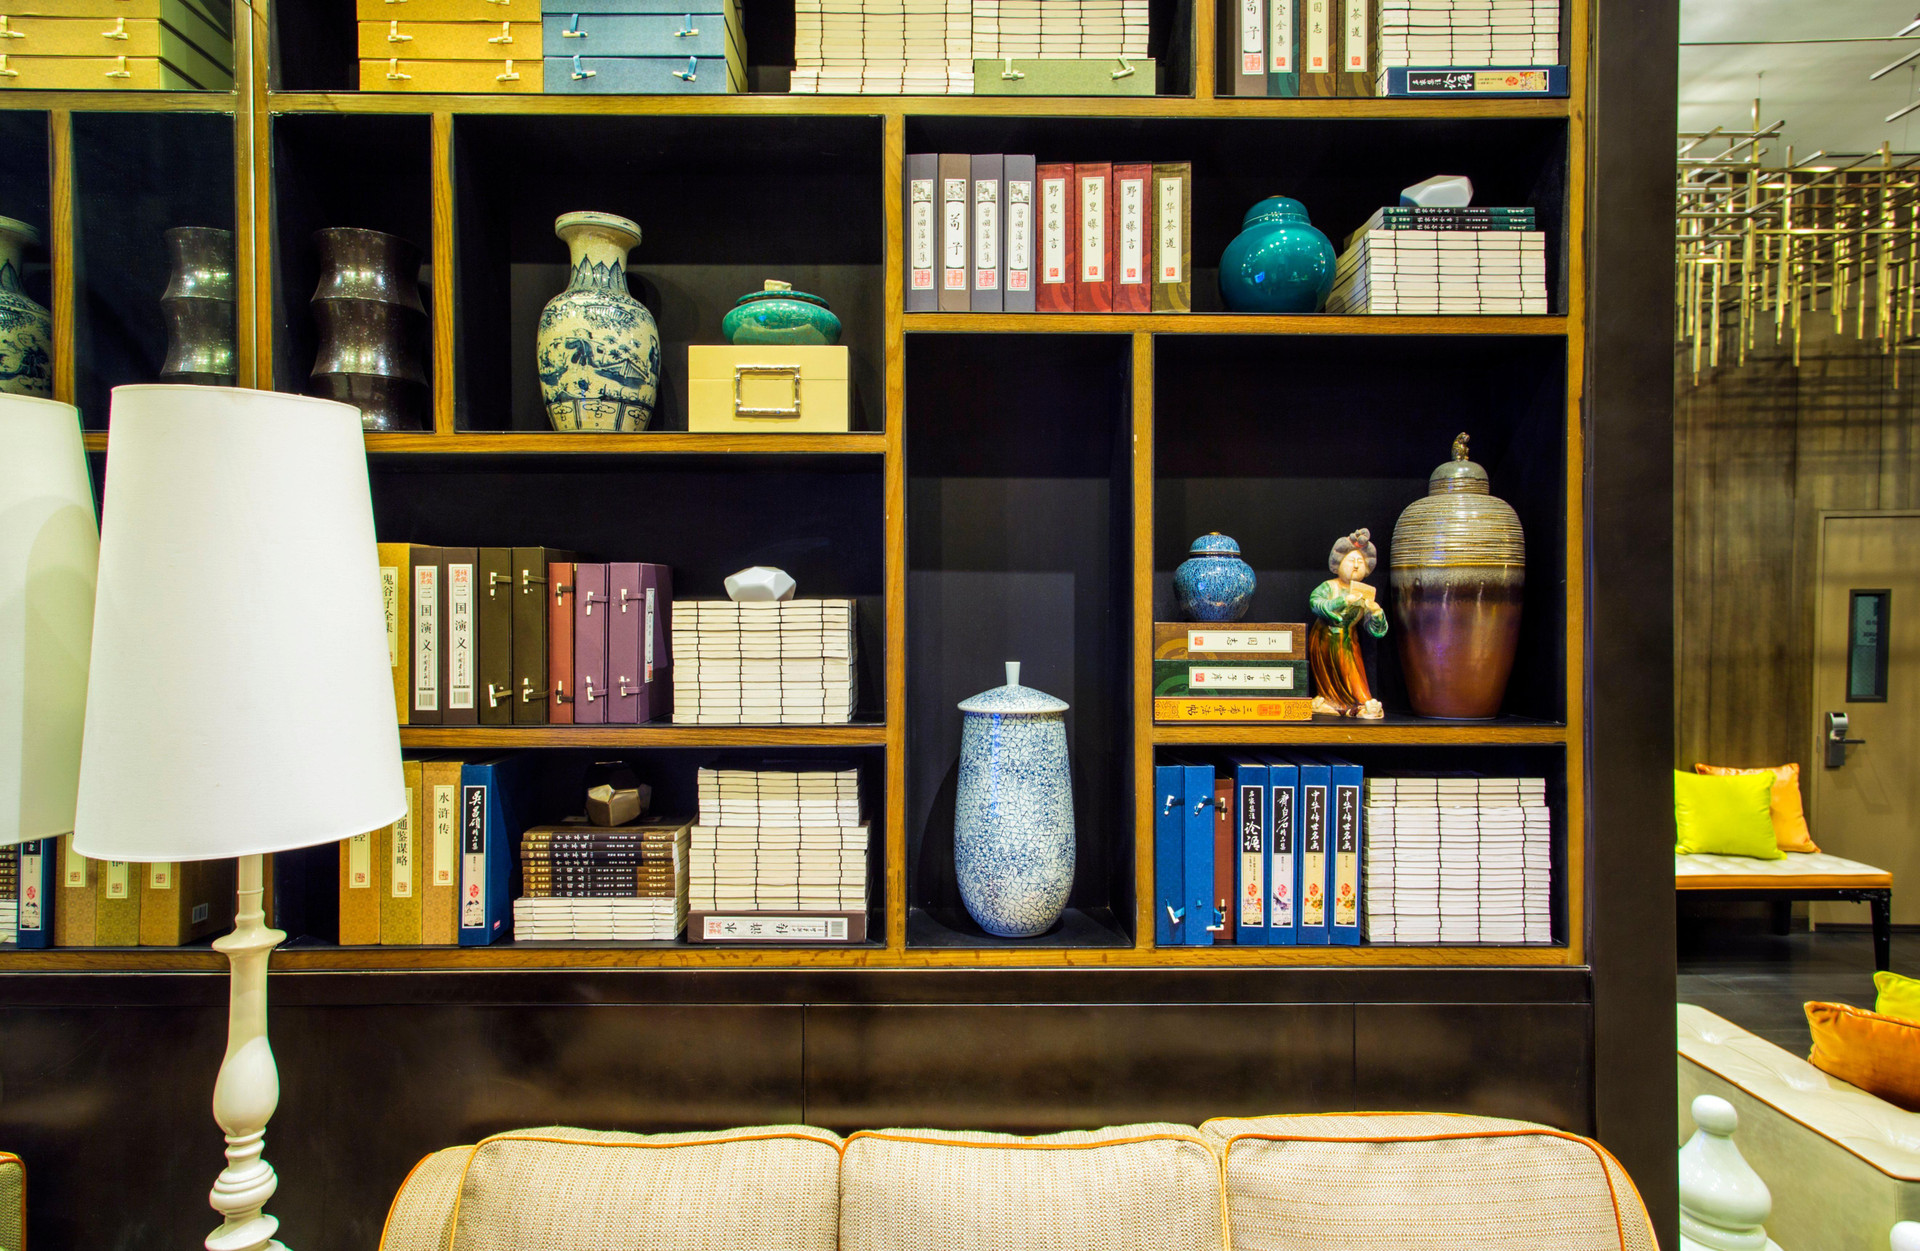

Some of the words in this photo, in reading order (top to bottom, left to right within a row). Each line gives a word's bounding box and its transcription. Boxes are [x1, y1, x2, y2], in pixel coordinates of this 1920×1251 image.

[1350, 0, 1363, 38] 茶道
[947, 213, 963, 256] 荀子
[1047, 184, 1060, 250] 野叟曝言
[1087, 183, 1099, 248] 野叟曝言
[1125, 185, 1137, 250] 野叟曝言
[1164, 184, 1177, 249] 中华茶道
[383, 573, 394, 633] 鬼谷子全集
[420, 586, 433, 652] 三国演义
[455, 584, 468, 650] 三国演义
[1185, 704, 1253, 716] 三希堂法帖
[437, 792, 450, 835] 水浒传
[724, 922, 789, 935] 水浒传
